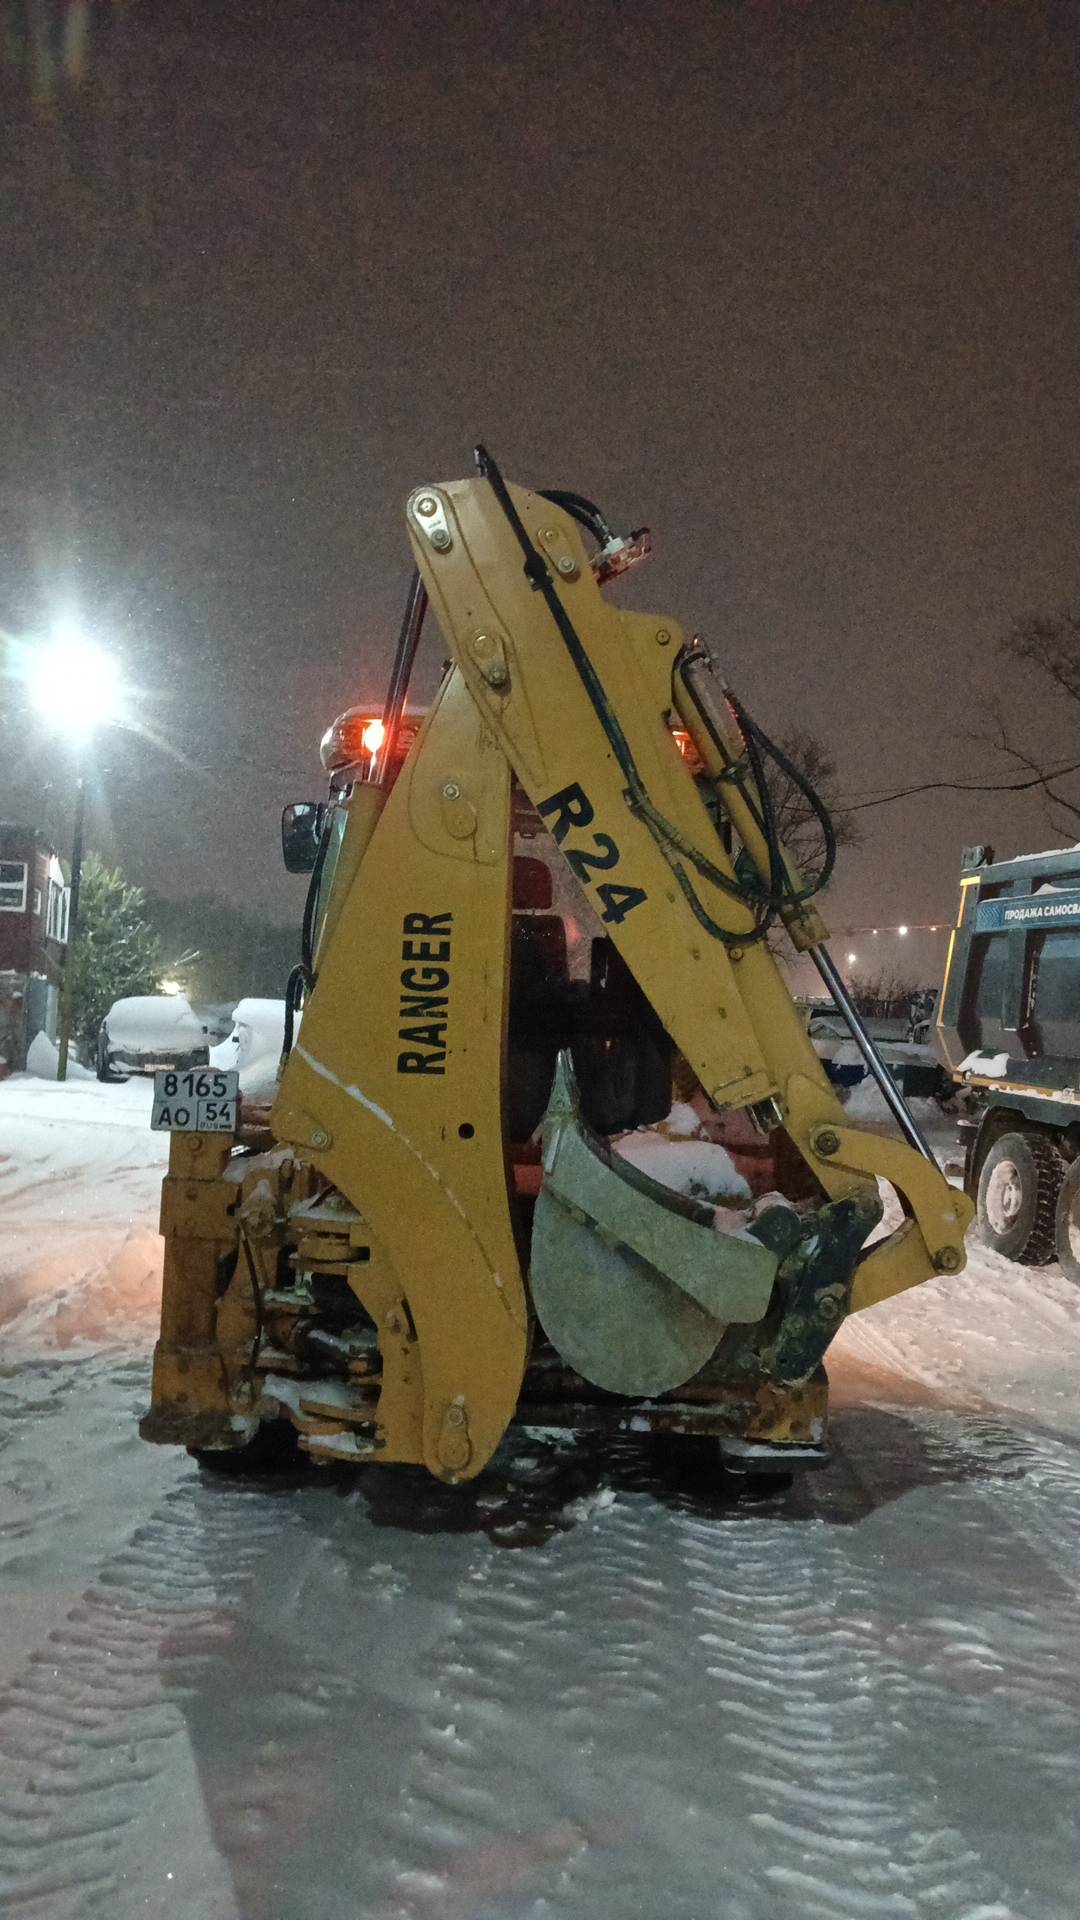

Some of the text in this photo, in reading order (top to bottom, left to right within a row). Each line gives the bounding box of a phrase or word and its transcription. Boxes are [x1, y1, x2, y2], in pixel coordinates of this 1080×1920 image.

[536, 782, 648, 924] R24
[1004, 907, 1042, 920] ПРОДАЖА
[397, 912, 453, 1075] RANGER
[164, 1073, 227, 1097] 8165
[206, 1102, 230, 1121] 54
